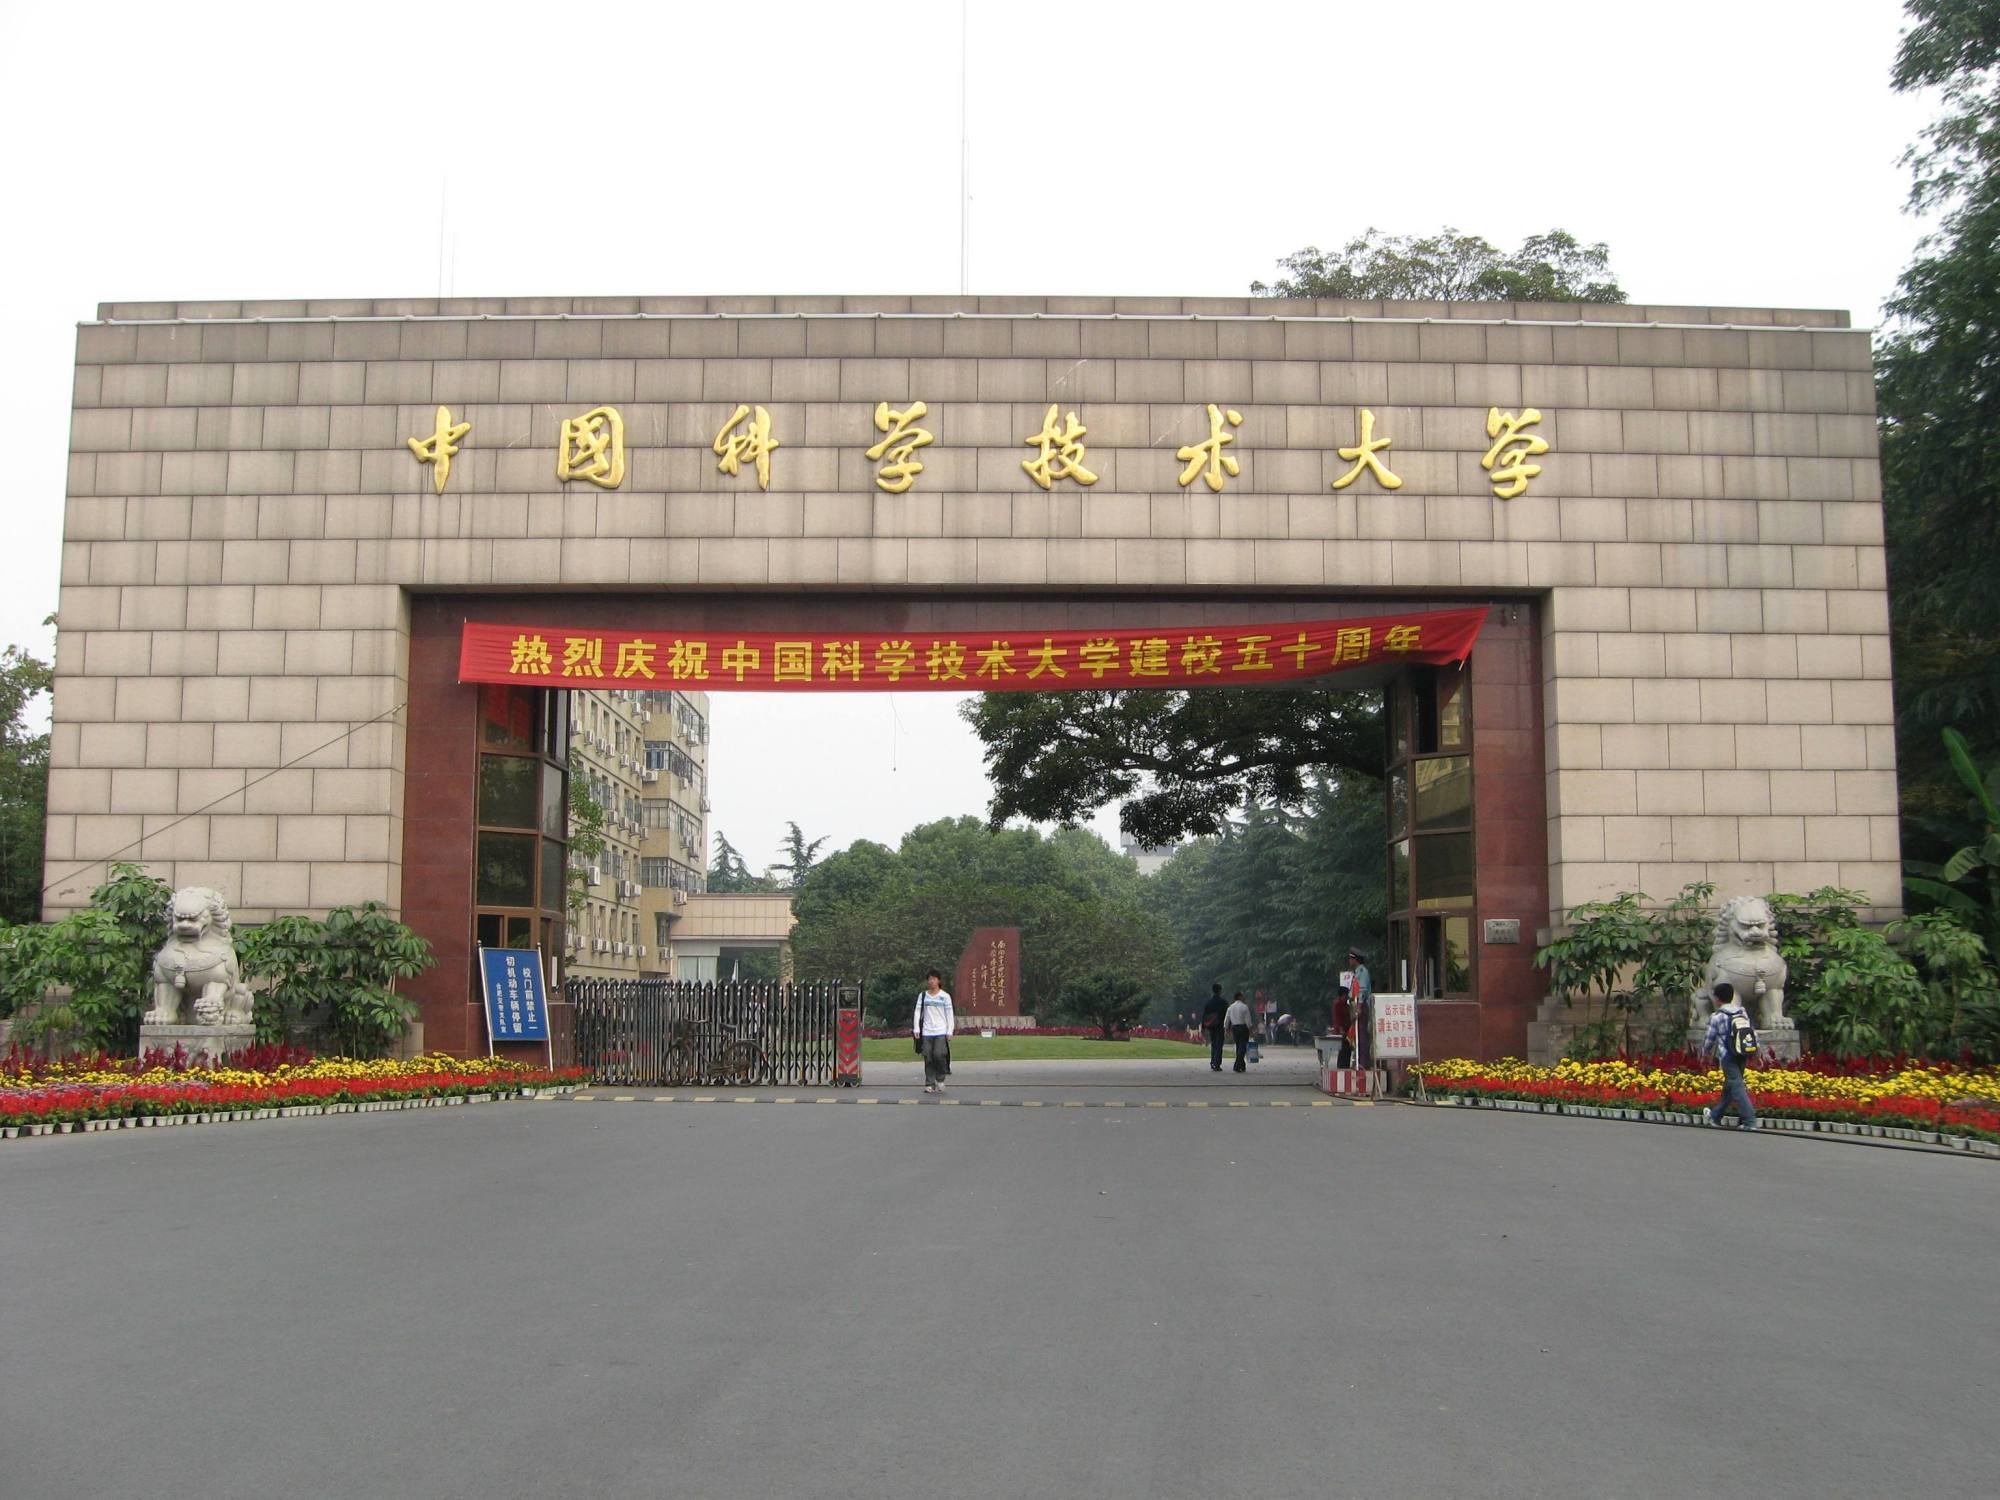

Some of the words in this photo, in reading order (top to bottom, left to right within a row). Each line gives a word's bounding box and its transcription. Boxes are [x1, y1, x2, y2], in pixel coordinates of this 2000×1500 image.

[508, 623, 1423, 684] 热烈庆祝中国科学技术大学建校五十周年
